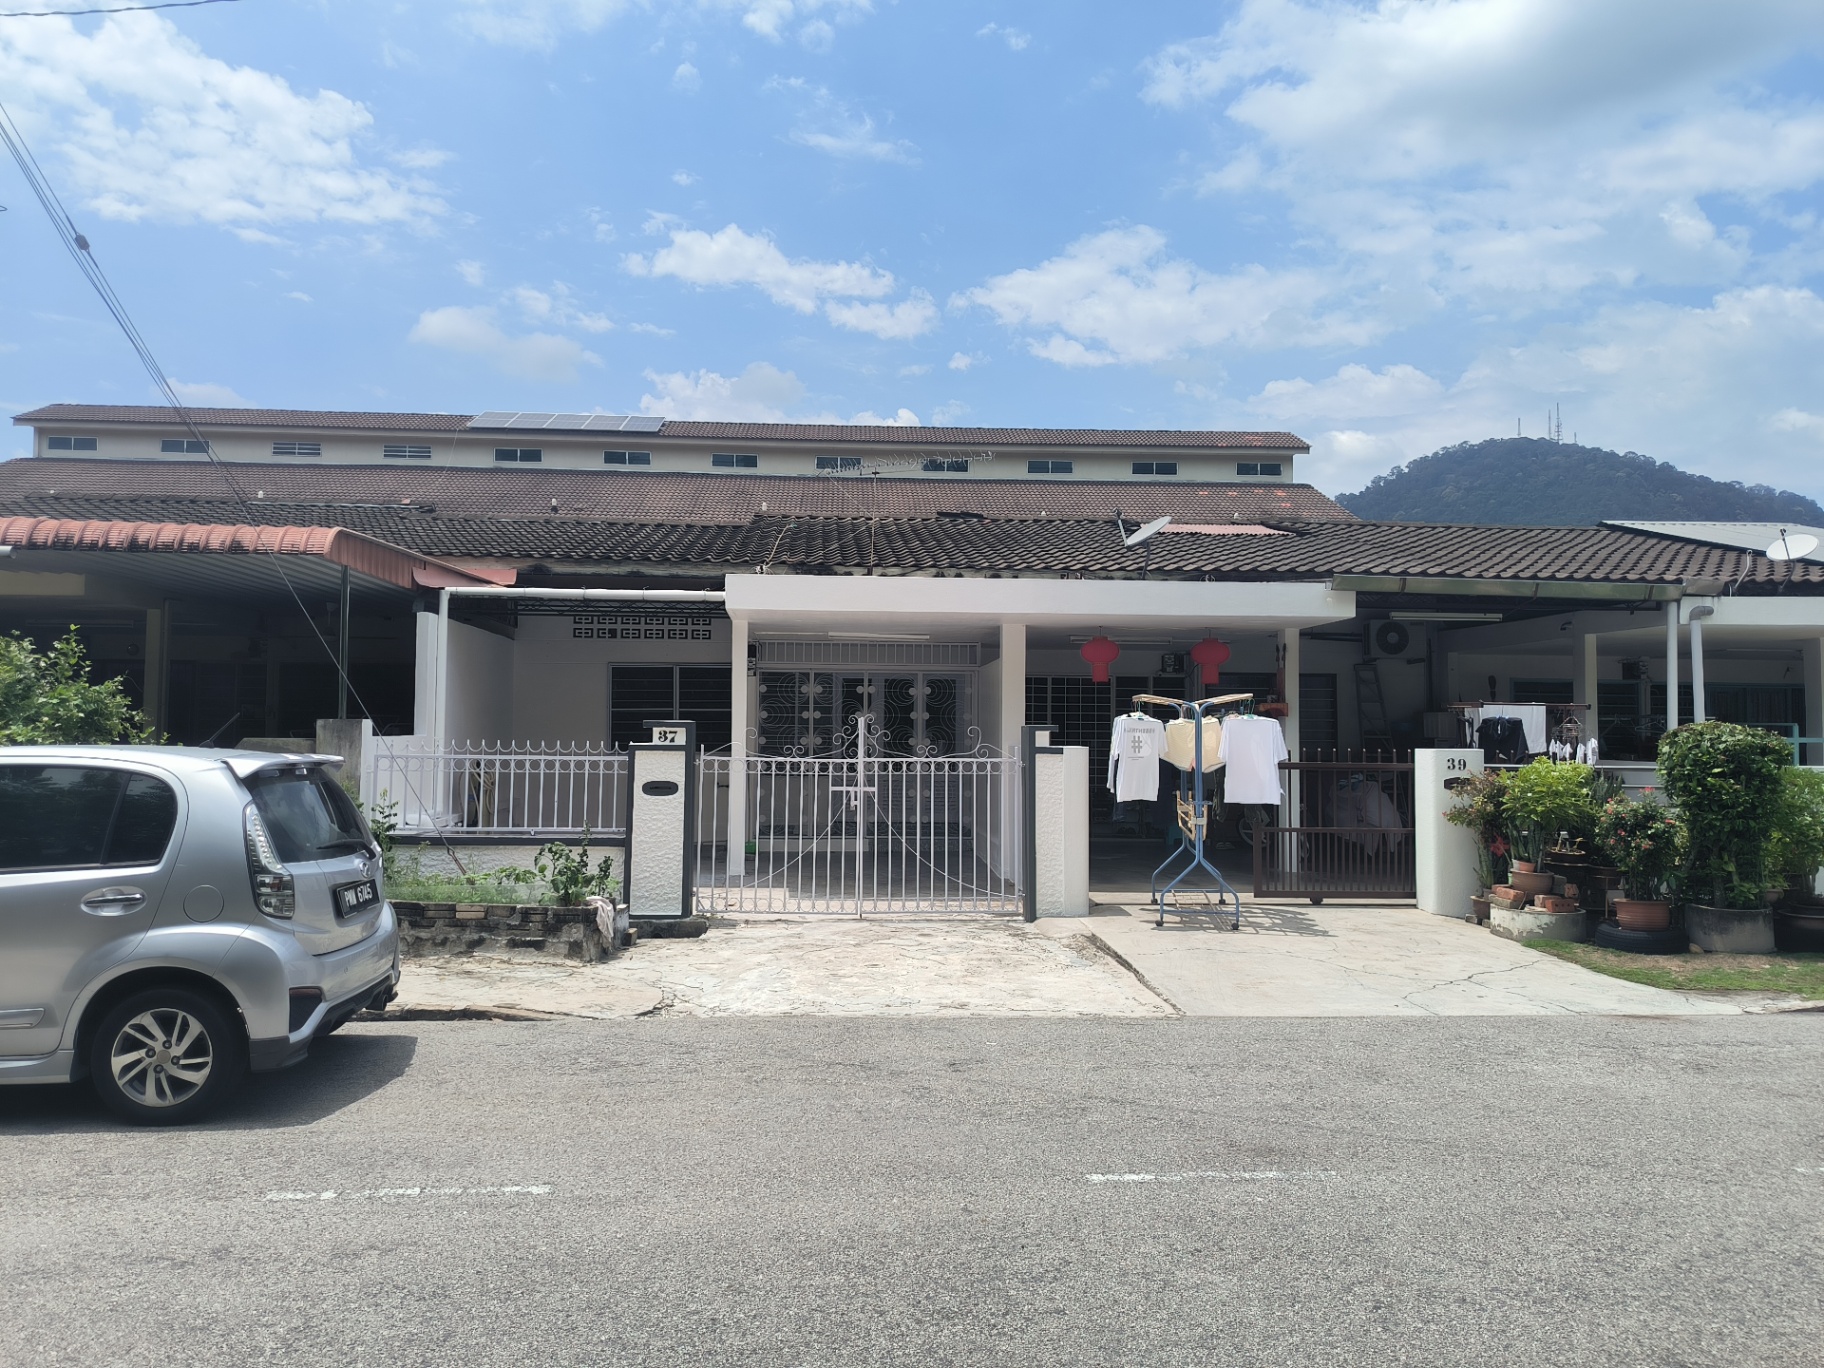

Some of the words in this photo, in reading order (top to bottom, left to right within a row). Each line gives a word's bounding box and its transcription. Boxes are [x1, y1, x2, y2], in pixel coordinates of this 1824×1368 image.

[658, 730, 678, 743] 37
[1447, 757, 1467, 771] 39
[357, 883, 373, 902] 6745
